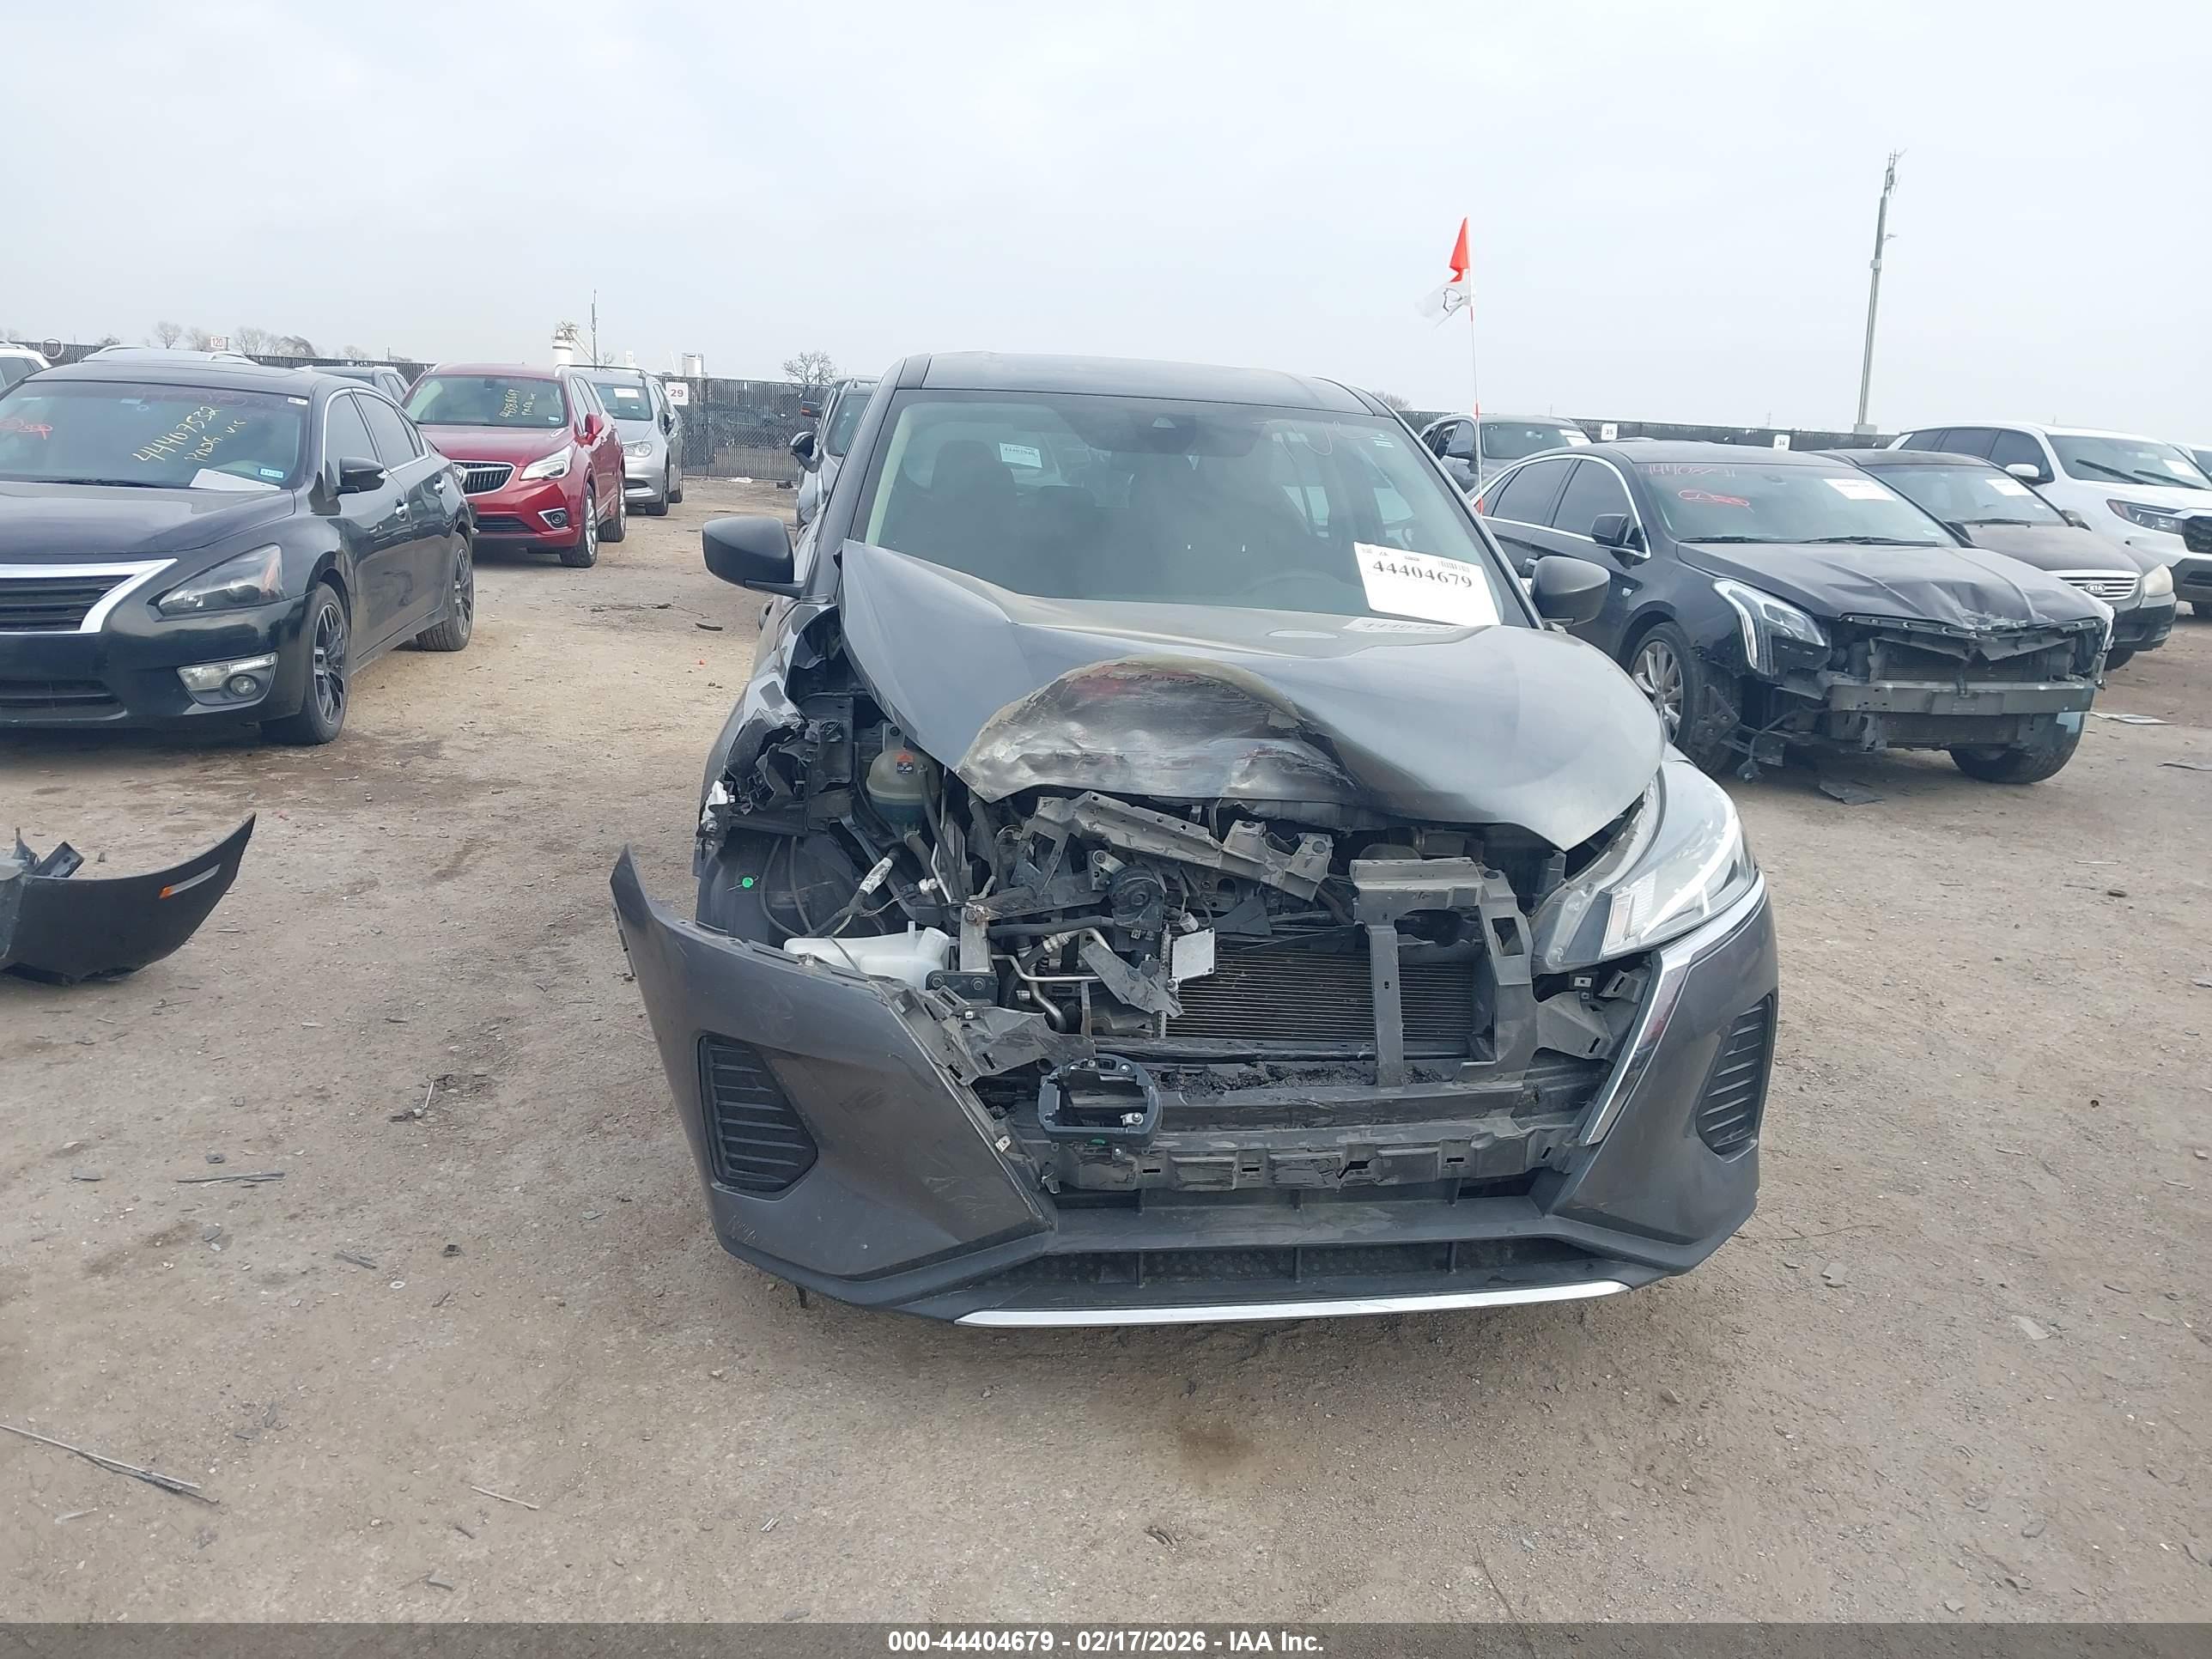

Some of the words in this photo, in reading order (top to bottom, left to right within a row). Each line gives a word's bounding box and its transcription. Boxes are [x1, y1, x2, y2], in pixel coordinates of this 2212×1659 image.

[670, 388, 684, 398] 29
[131, 405, 222, 461] 44407532
[1373, 561, 1472, 587] 44404679
